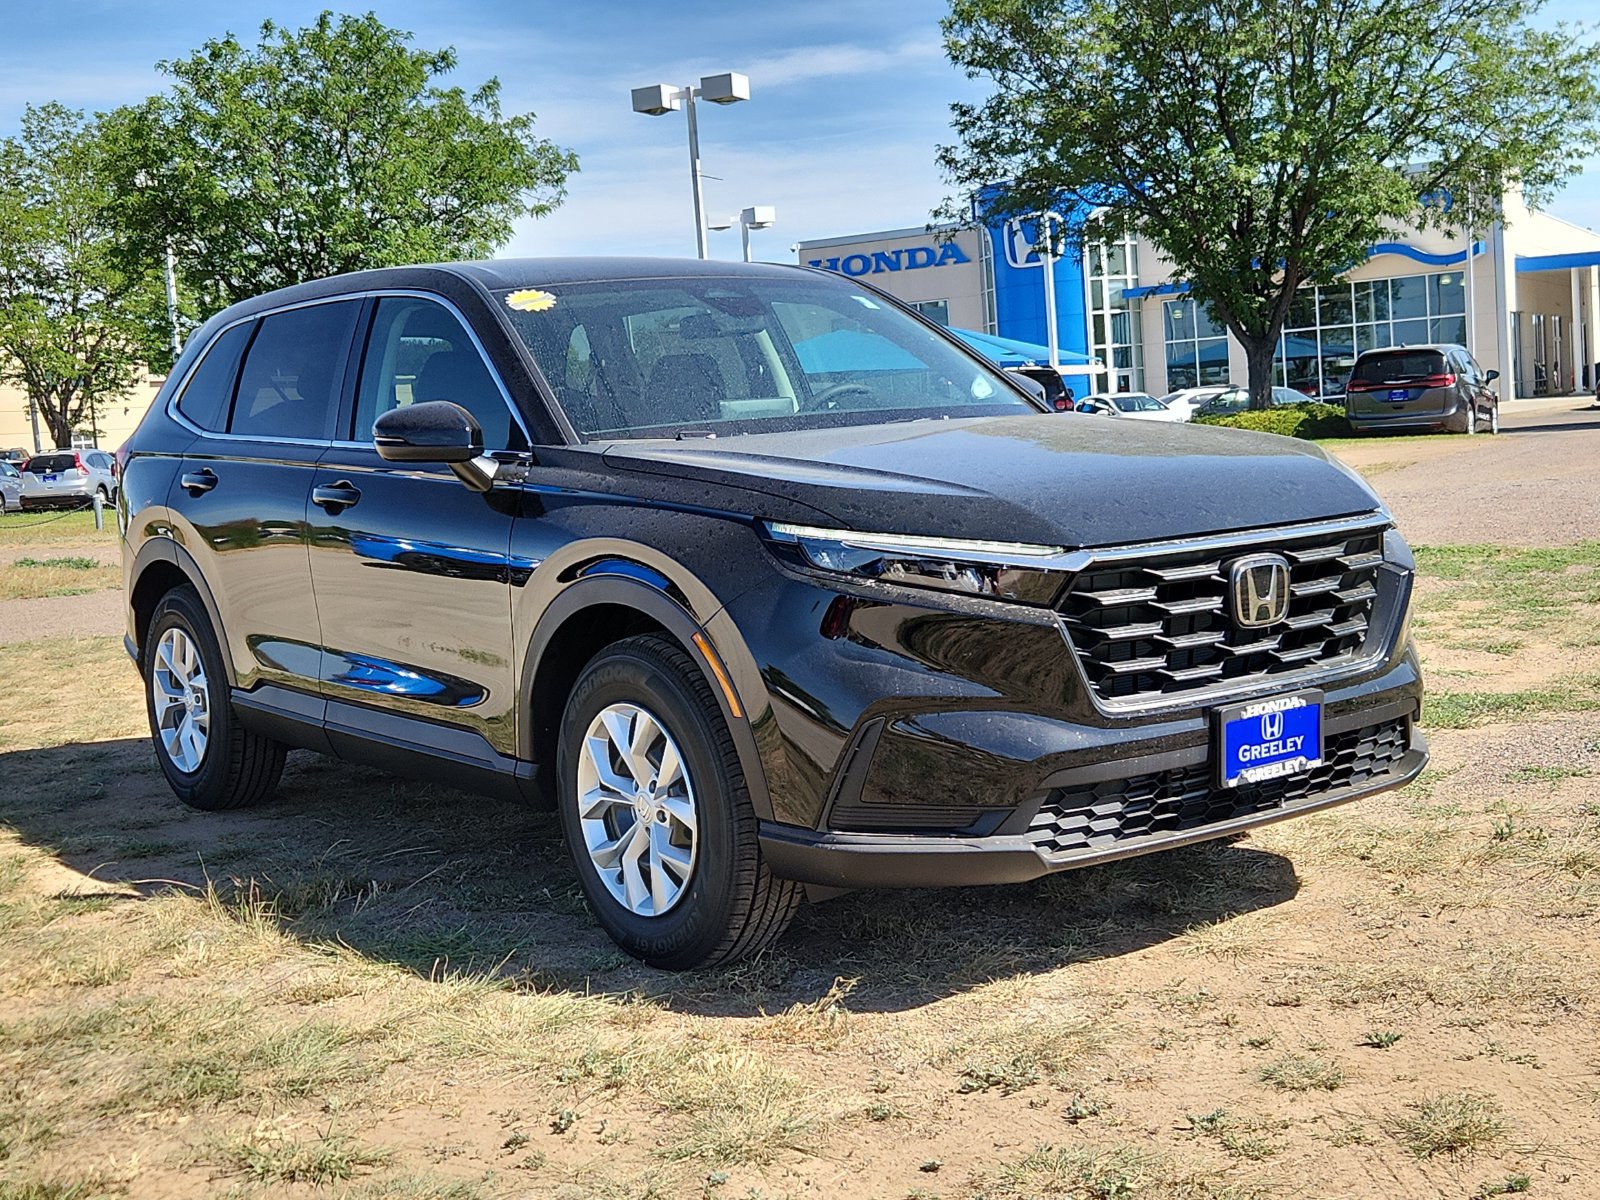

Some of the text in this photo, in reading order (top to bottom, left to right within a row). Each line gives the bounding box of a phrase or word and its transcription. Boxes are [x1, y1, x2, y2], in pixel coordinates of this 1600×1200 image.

[1244, 696, 1302, 718] HONDA
[1238, 735, 1305, 762] GREELEY
[1246, 759, 1301, 783] GREELEY
